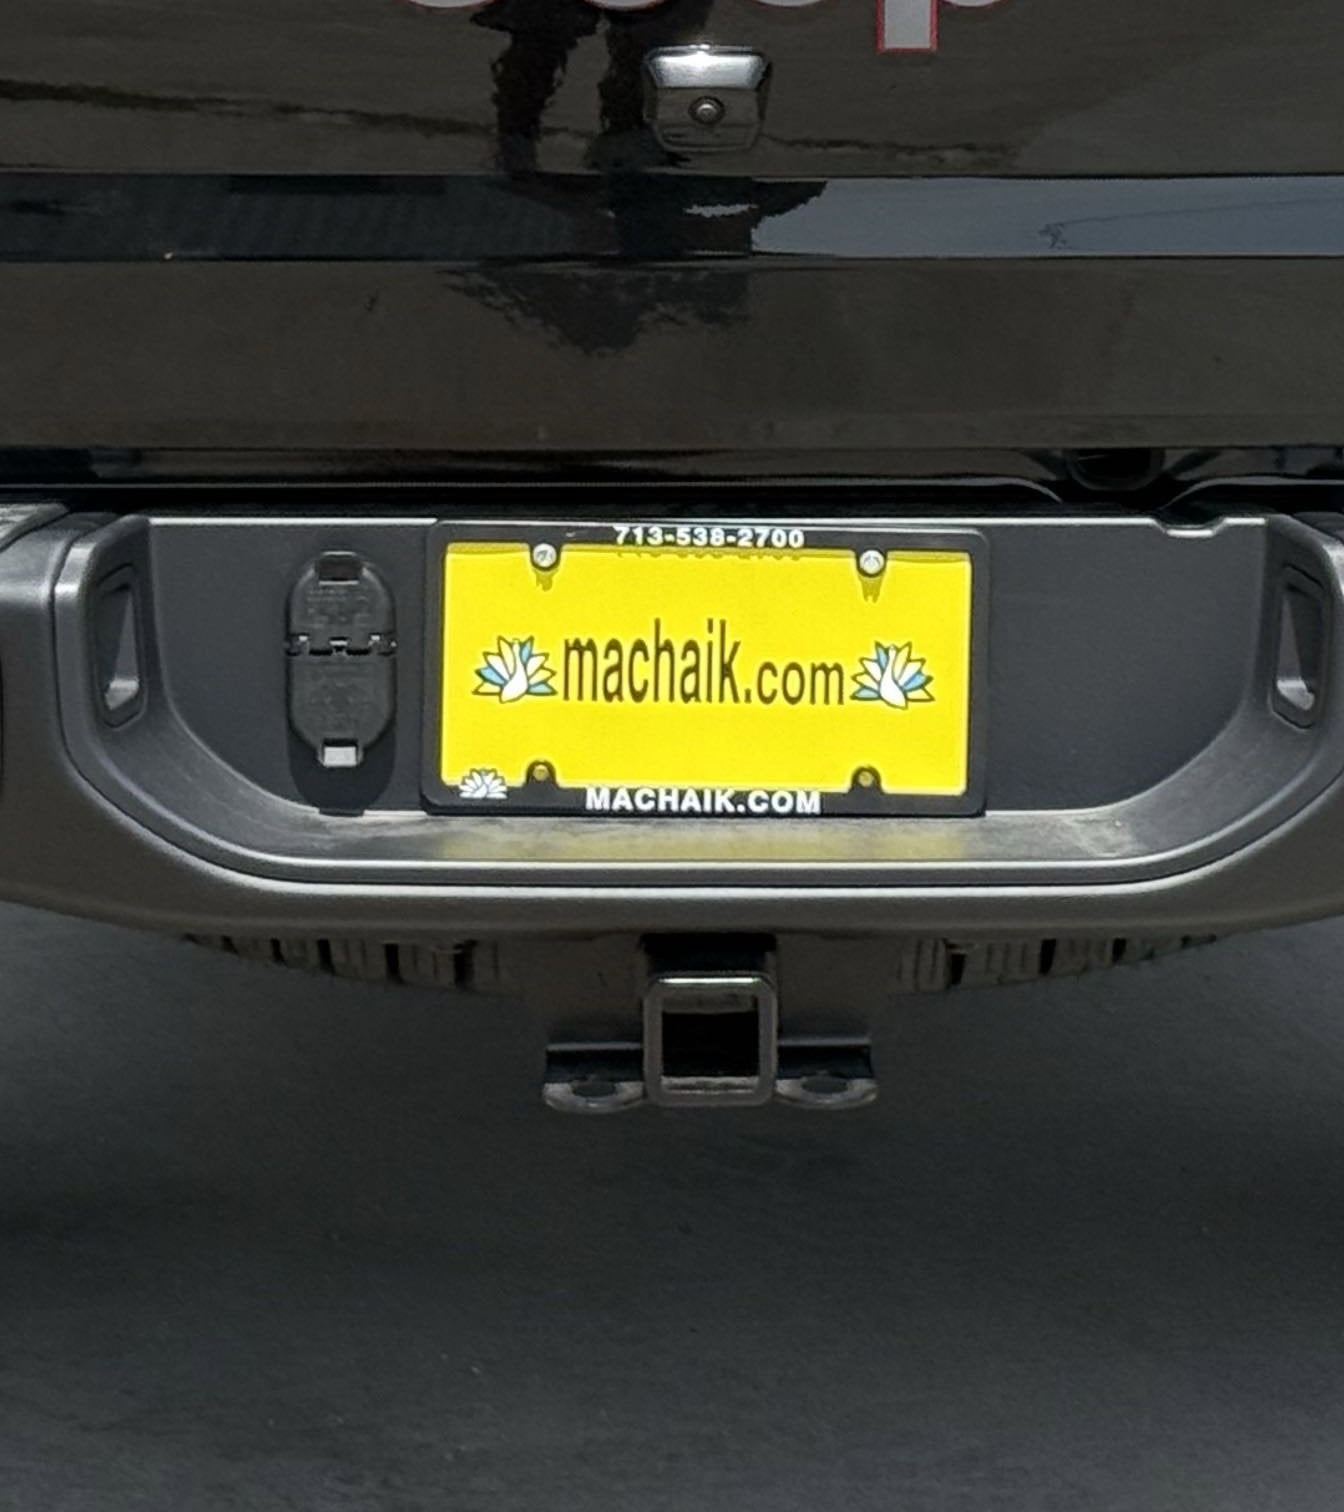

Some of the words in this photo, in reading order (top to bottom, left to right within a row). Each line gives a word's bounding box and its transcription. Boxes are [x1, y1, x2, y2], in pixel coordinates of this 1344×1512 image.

[613, 525, 805, 548] 713-538-2700
[562, 617, 845, 705] machaik.com
[585, 787, 822, 814] MACHAIK.COM
